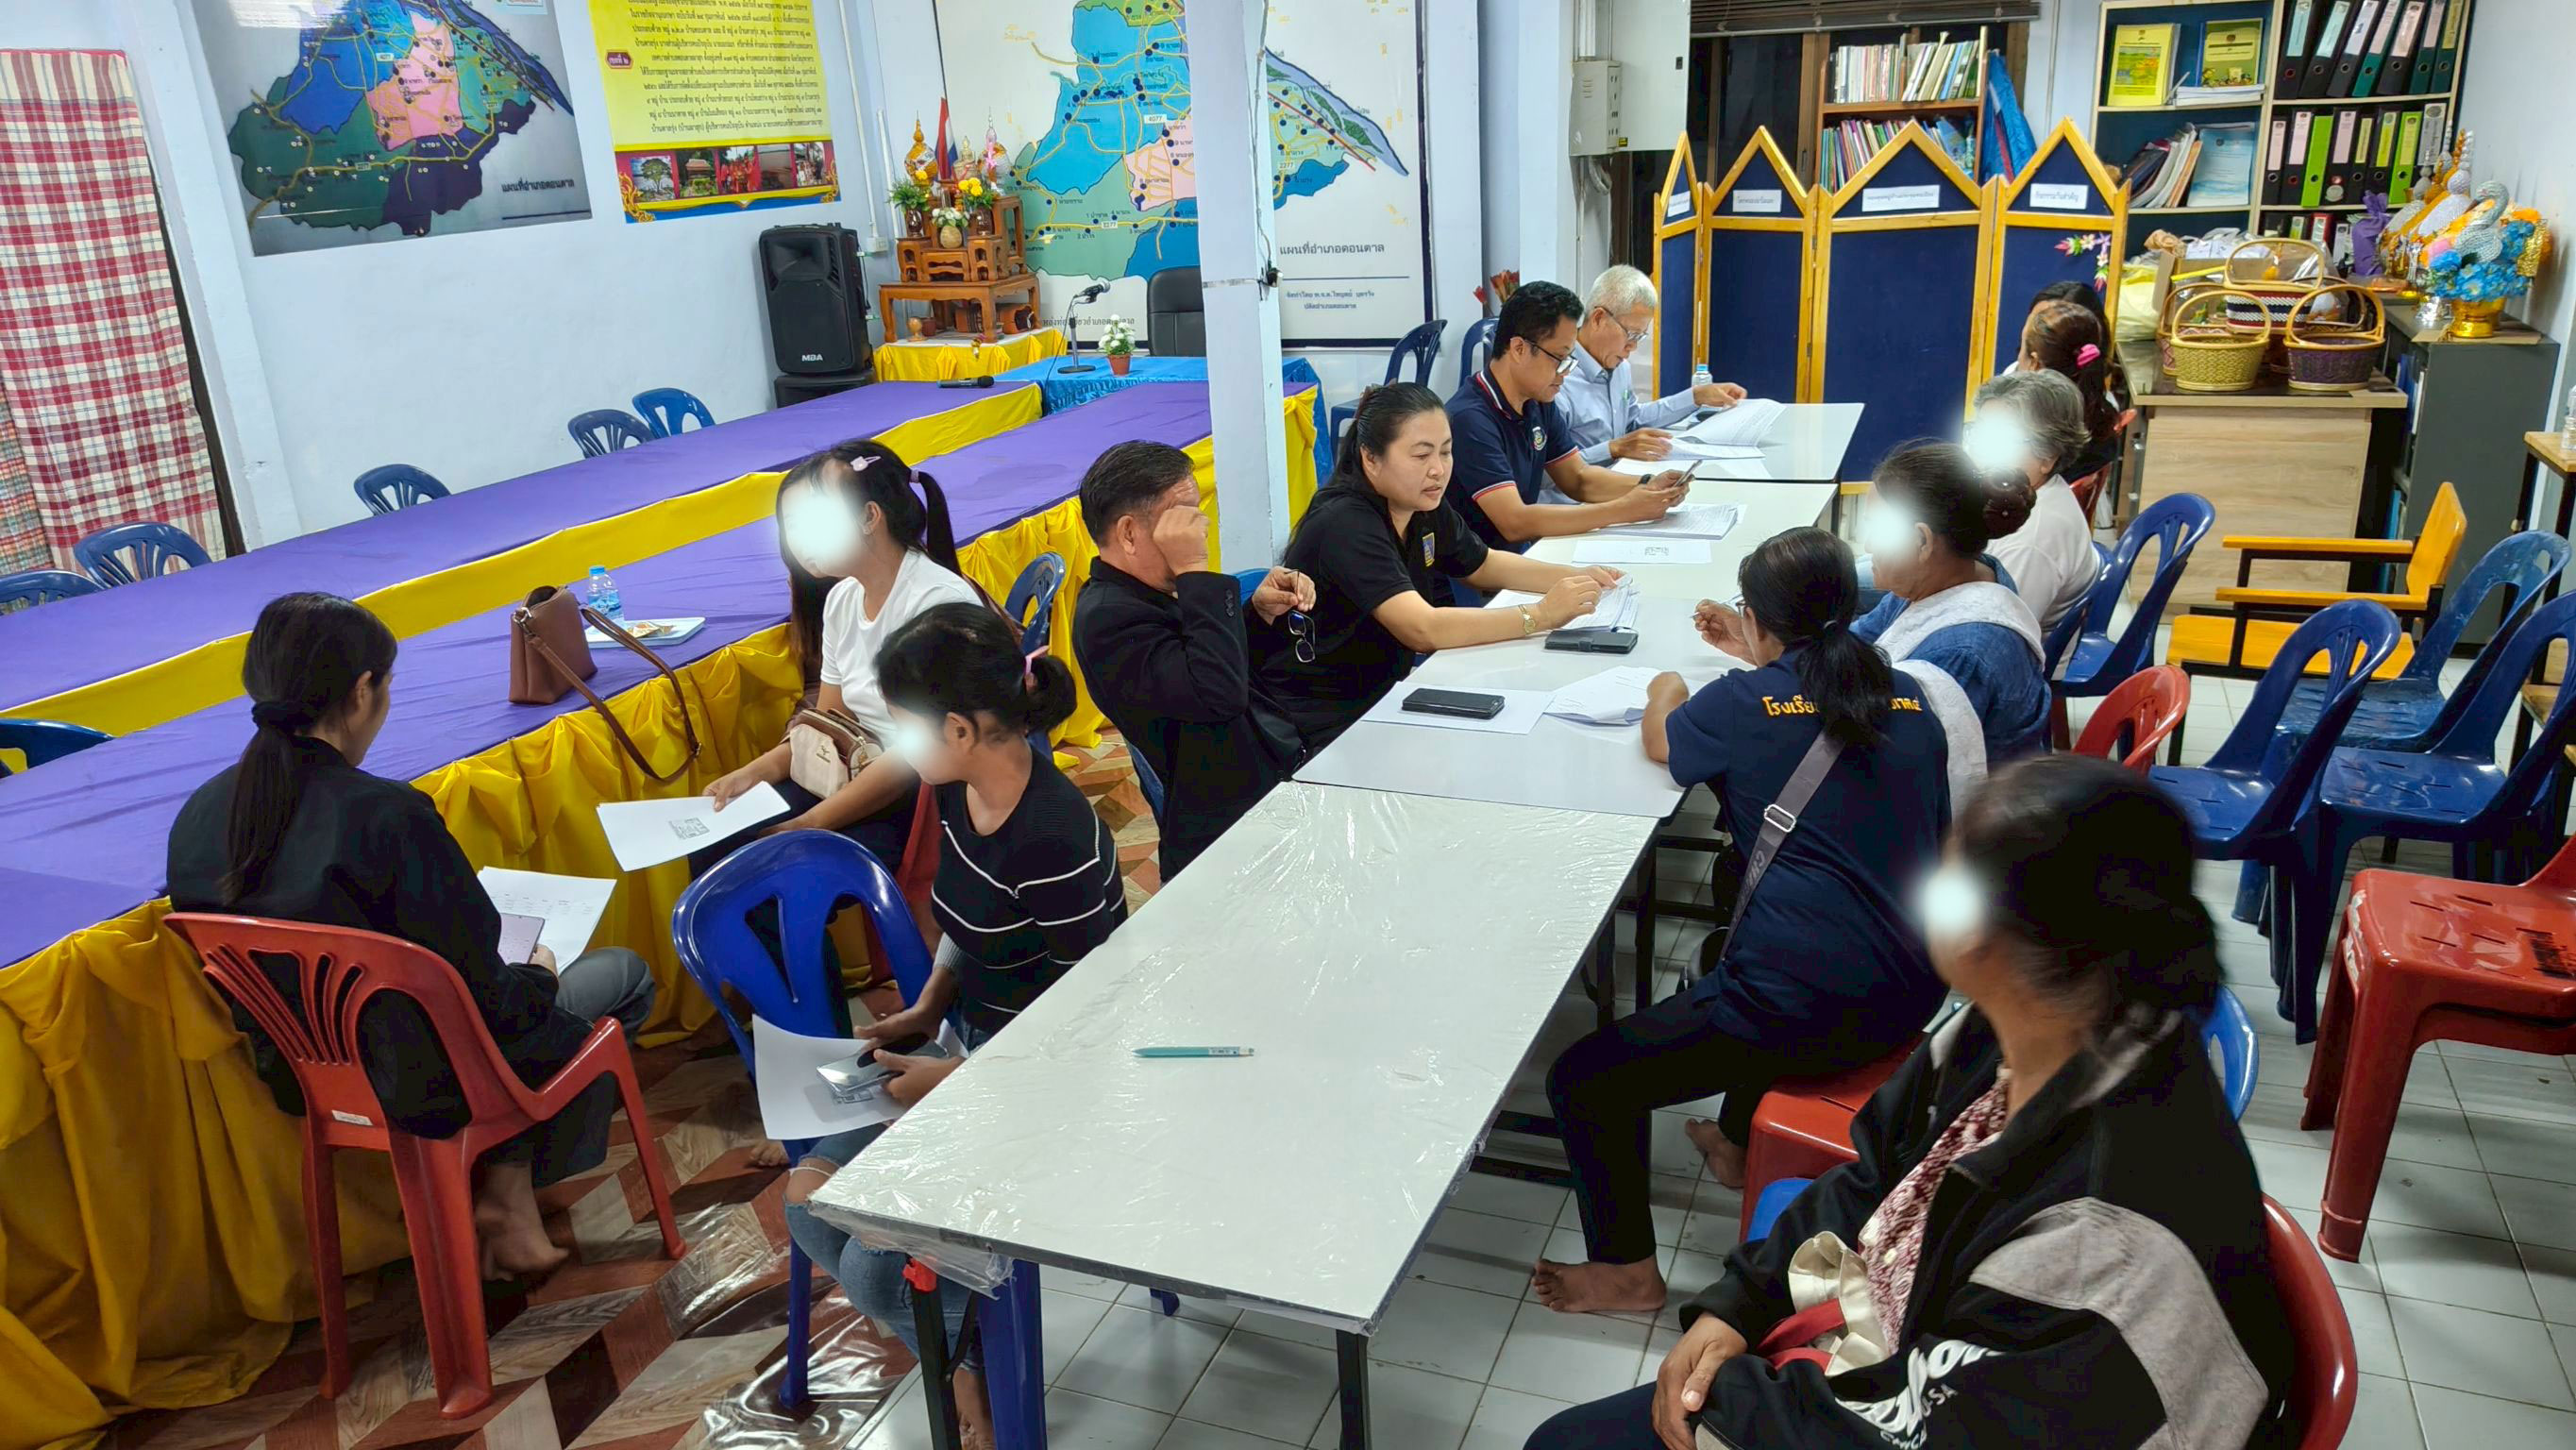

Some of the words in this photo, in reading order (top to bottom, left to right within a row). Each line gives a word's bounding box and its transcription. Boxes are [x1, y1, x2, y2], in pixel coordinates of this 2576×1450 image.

[1280, 242, 1385, 255] แผนที่อำเภอดอนตาล
[1761, 694, 1820, 717] โรงเรีย
